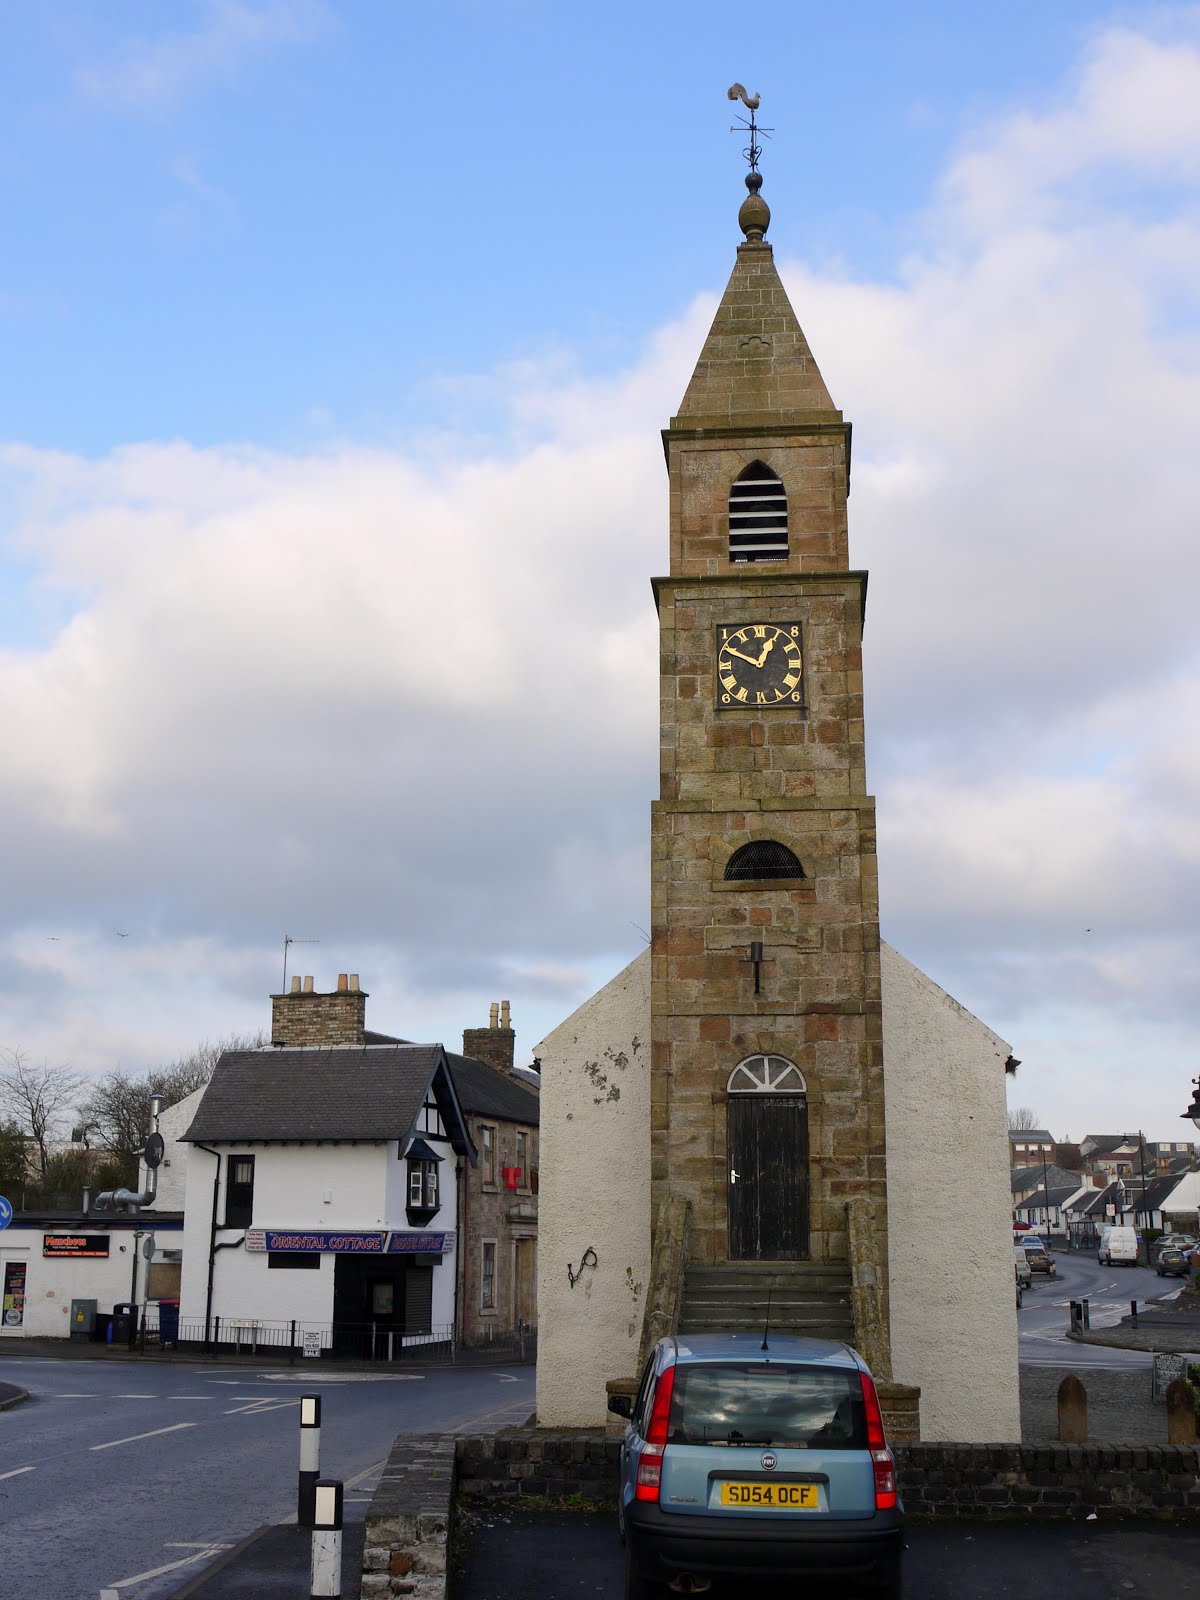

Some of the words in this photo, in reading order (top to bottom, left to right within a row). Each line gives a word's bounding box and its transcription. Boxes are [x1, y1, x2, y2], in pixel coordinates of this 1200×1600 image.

[721, 628, 729, 640] 1
[752, 625, 766, 638] XII
[790, 626, 799, 638] 8
[788, 658, 801, 669] III
[721, 693, 731, 704] 6
[791, 691, 800, 702] 6
[271, 1236, 327, 1249] ORIENTAL
[328, 1236, 381, 1250] COTTAGE
[729, 1486, 773, 1503] SD54
[778, 1487, 811, 1504] OCF
